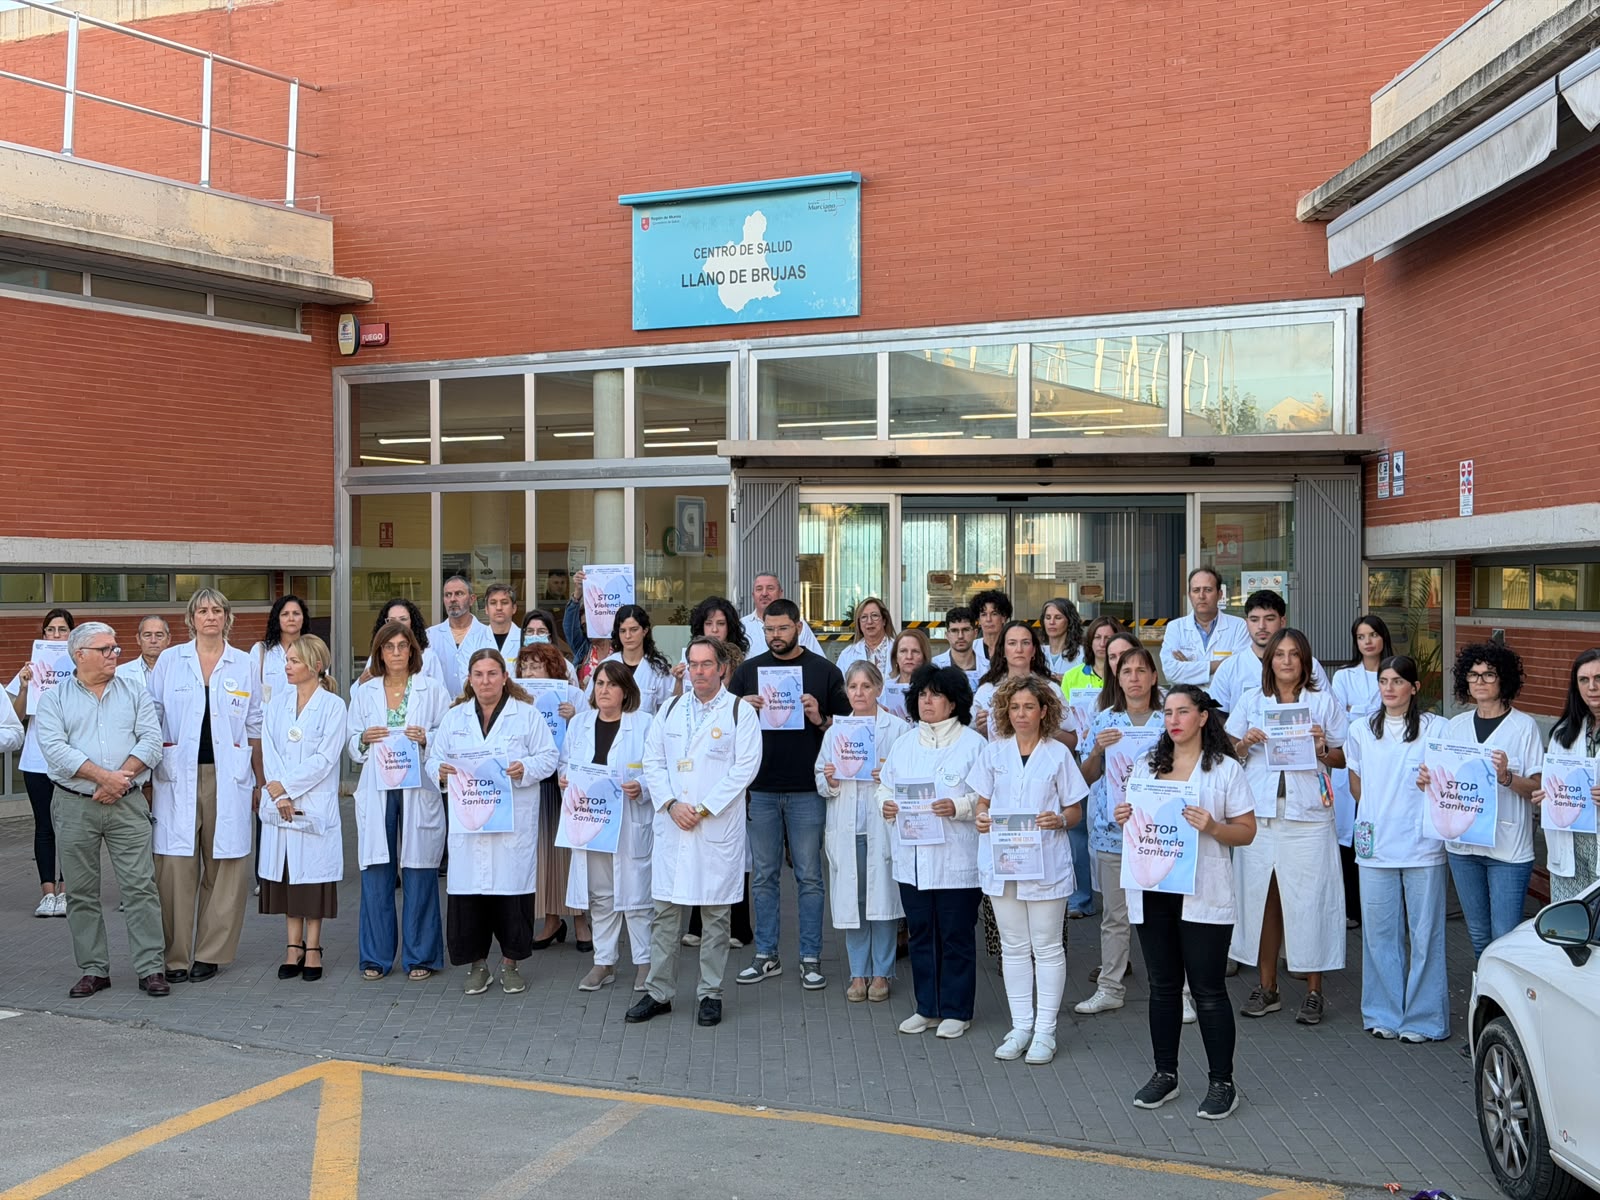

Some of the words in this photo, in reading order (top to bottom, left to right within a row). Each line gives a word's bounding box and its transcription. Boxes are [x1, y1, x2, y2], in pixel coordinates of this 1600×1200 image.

[694, 245, 737, 259] CENTRO
[740, 244, 754, 256] DE
[757, 240, 792, 254] SALUD
[681, 271, 725, 288] LLANO
[729, 269, 747, 284] DE
[751, 264, 806, 282] BRUJAS
[362, 333, 383, 341] FUEGO
[385, 756, 411, 764] Violencia
[1446, 781, 1478, 791] STOP
[462, 797, 502, 805] Sanitaria
[579, 797, 606, 805] STOP
[1440, 791, 1485, 804] Violencia
[1554, 793, 1587, 801] Violencia
[1439, 801, 1484, 814] Sanitaria
[1554, 800, 1586, 808] Sanitaria
[574, 806, 611, 815] Violencia
[573, 814, 611, 824] Sanitaria
[1145, 824, 1178, 834] STOP
[1138, 835, 1184, 847] Violencia
[1137, 847, 1184, 858] Sanitaria
